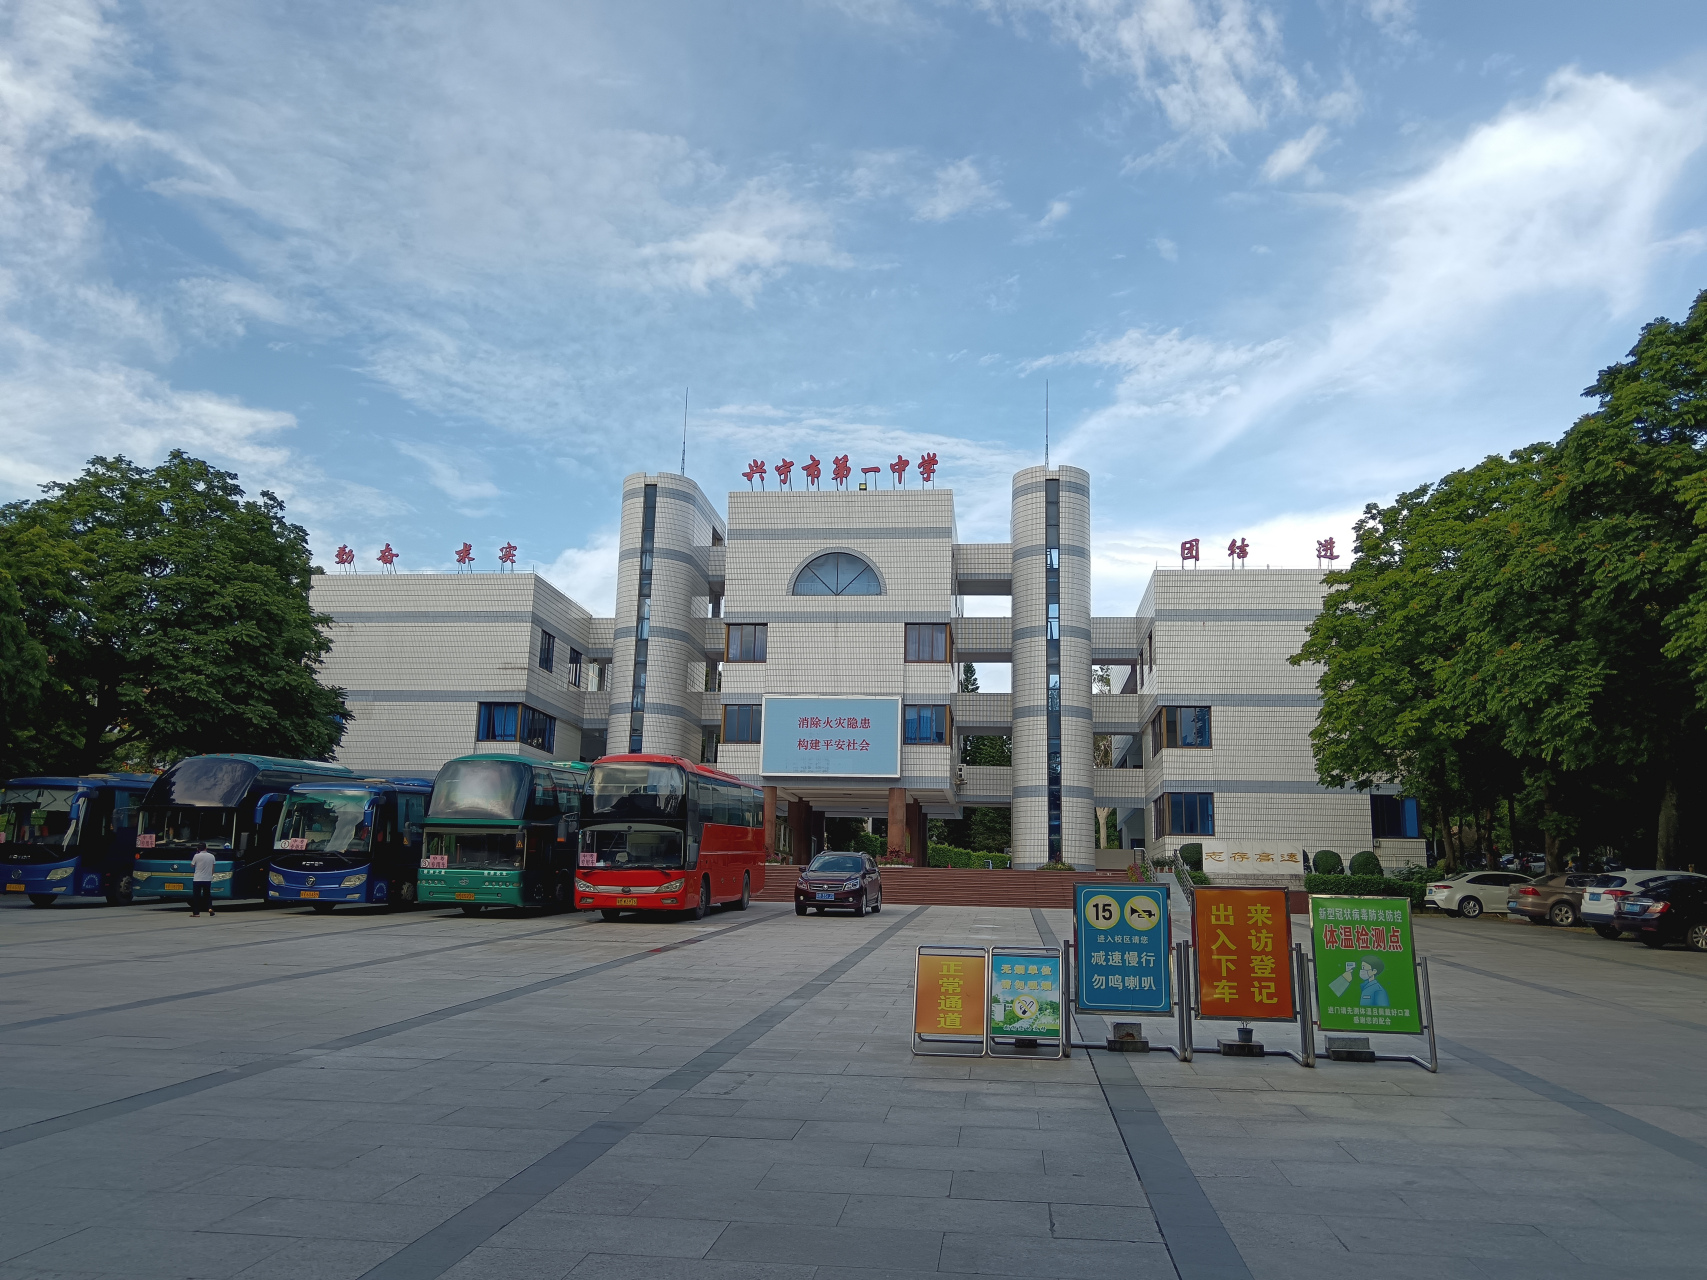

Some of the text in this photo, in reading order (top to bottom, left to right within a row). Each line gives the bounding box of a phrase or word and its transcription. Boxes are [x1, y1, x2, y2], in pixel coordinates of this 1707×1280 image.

[742, 452, 938, 486] 兴宁市第一中学
[1181, 538, 1249, 561] 团结
[798, 717, 871, 729] 消除火灾隐患
[797, 738, 871, 751] 构建平安社会
[1092, 903, 1112, 921] 15
[1318, 907, 1403, 922] 新型冠状病毒肺炎防控
[1097, 934, 1149, 944] 进入校区请您
[1322, 924, 1403, 951] 体温检测点
[1091, 950, 1155, 967] 减速慢行
[1211, 903, 1239, 1003] 出入下车
[1247, 903, 1278, 1004] 来访登记
[1001, 964, 1052, 976] 无烟单位
[1091, 974, 1156, 990] 勿鸣喇叭
[937, 961, 964, 1029] 正常通道
[1353, 1016, 1391, 1026] 感谢您的配合
